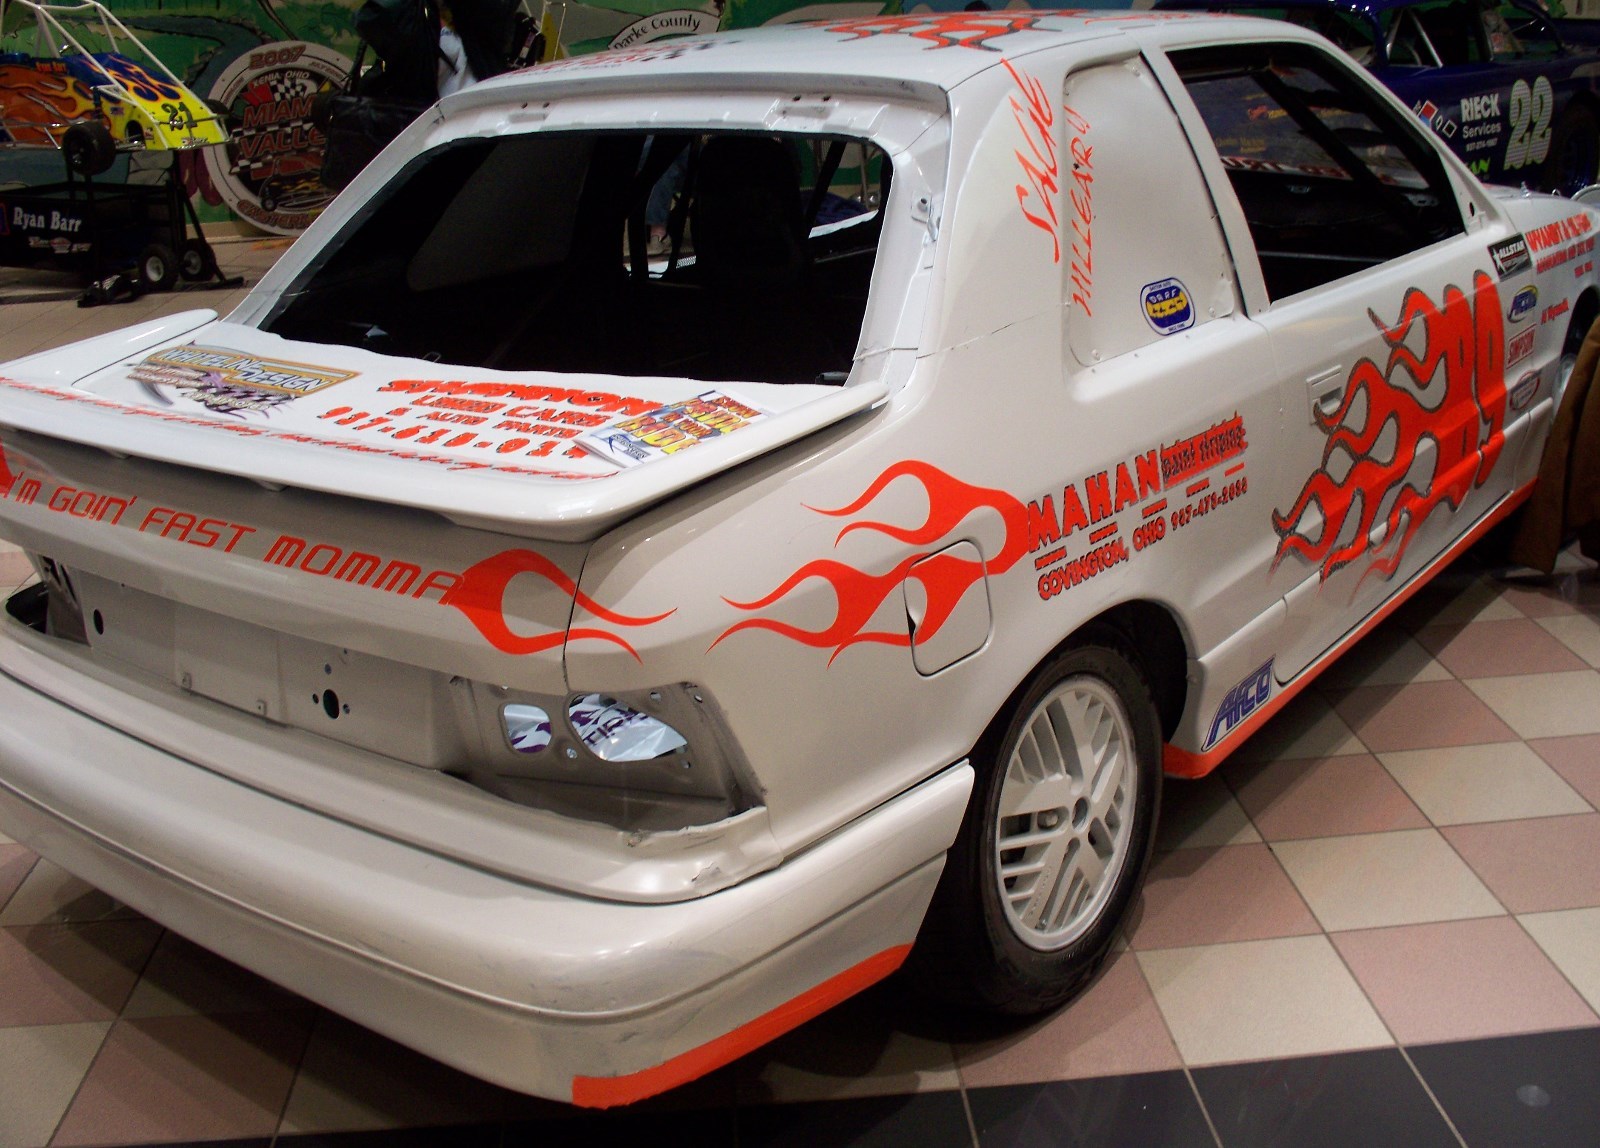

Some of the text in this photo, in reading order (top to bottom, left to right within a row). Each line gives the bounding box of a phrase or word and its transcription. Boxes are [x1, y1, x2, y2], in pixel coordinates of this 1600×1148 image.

[651, 14, 700, 32] County
[249, 45, 307, 70] 2007
[252, 72, 282, 89] XENIA
[284, 70, 310, 81] OHIO
[161, 102, 198, 131] 21
[243, 95, 319, 129] MIAM
[1461, 93, 1501, 123] RIECK
[1462, 121, 1502, 140] Services
[1503, 76, 1553, 170] 22
[240, 127, 328, 160] VALLE
[13, 206, 82, 232] Ryan Barr
[1498, 240, 1526, 259] ALLSTAR
[376, 378, 664, 417] SHANNON
[416, 410, 489, 426] AUTO
[491, 420, 583, 439] PARTS
[502, 405, 613, 427] CARS
[1027, 448, 1162, 554] MAHAN
[48, 485, 137, 526] GOIN'
[139, 506, 257, 555] FAST
[263, 534, 465, 606] MOMMA
[1037, 536, 1130, 601] COVINGTON,
[1132, 515, 1167, 552] OHIO
